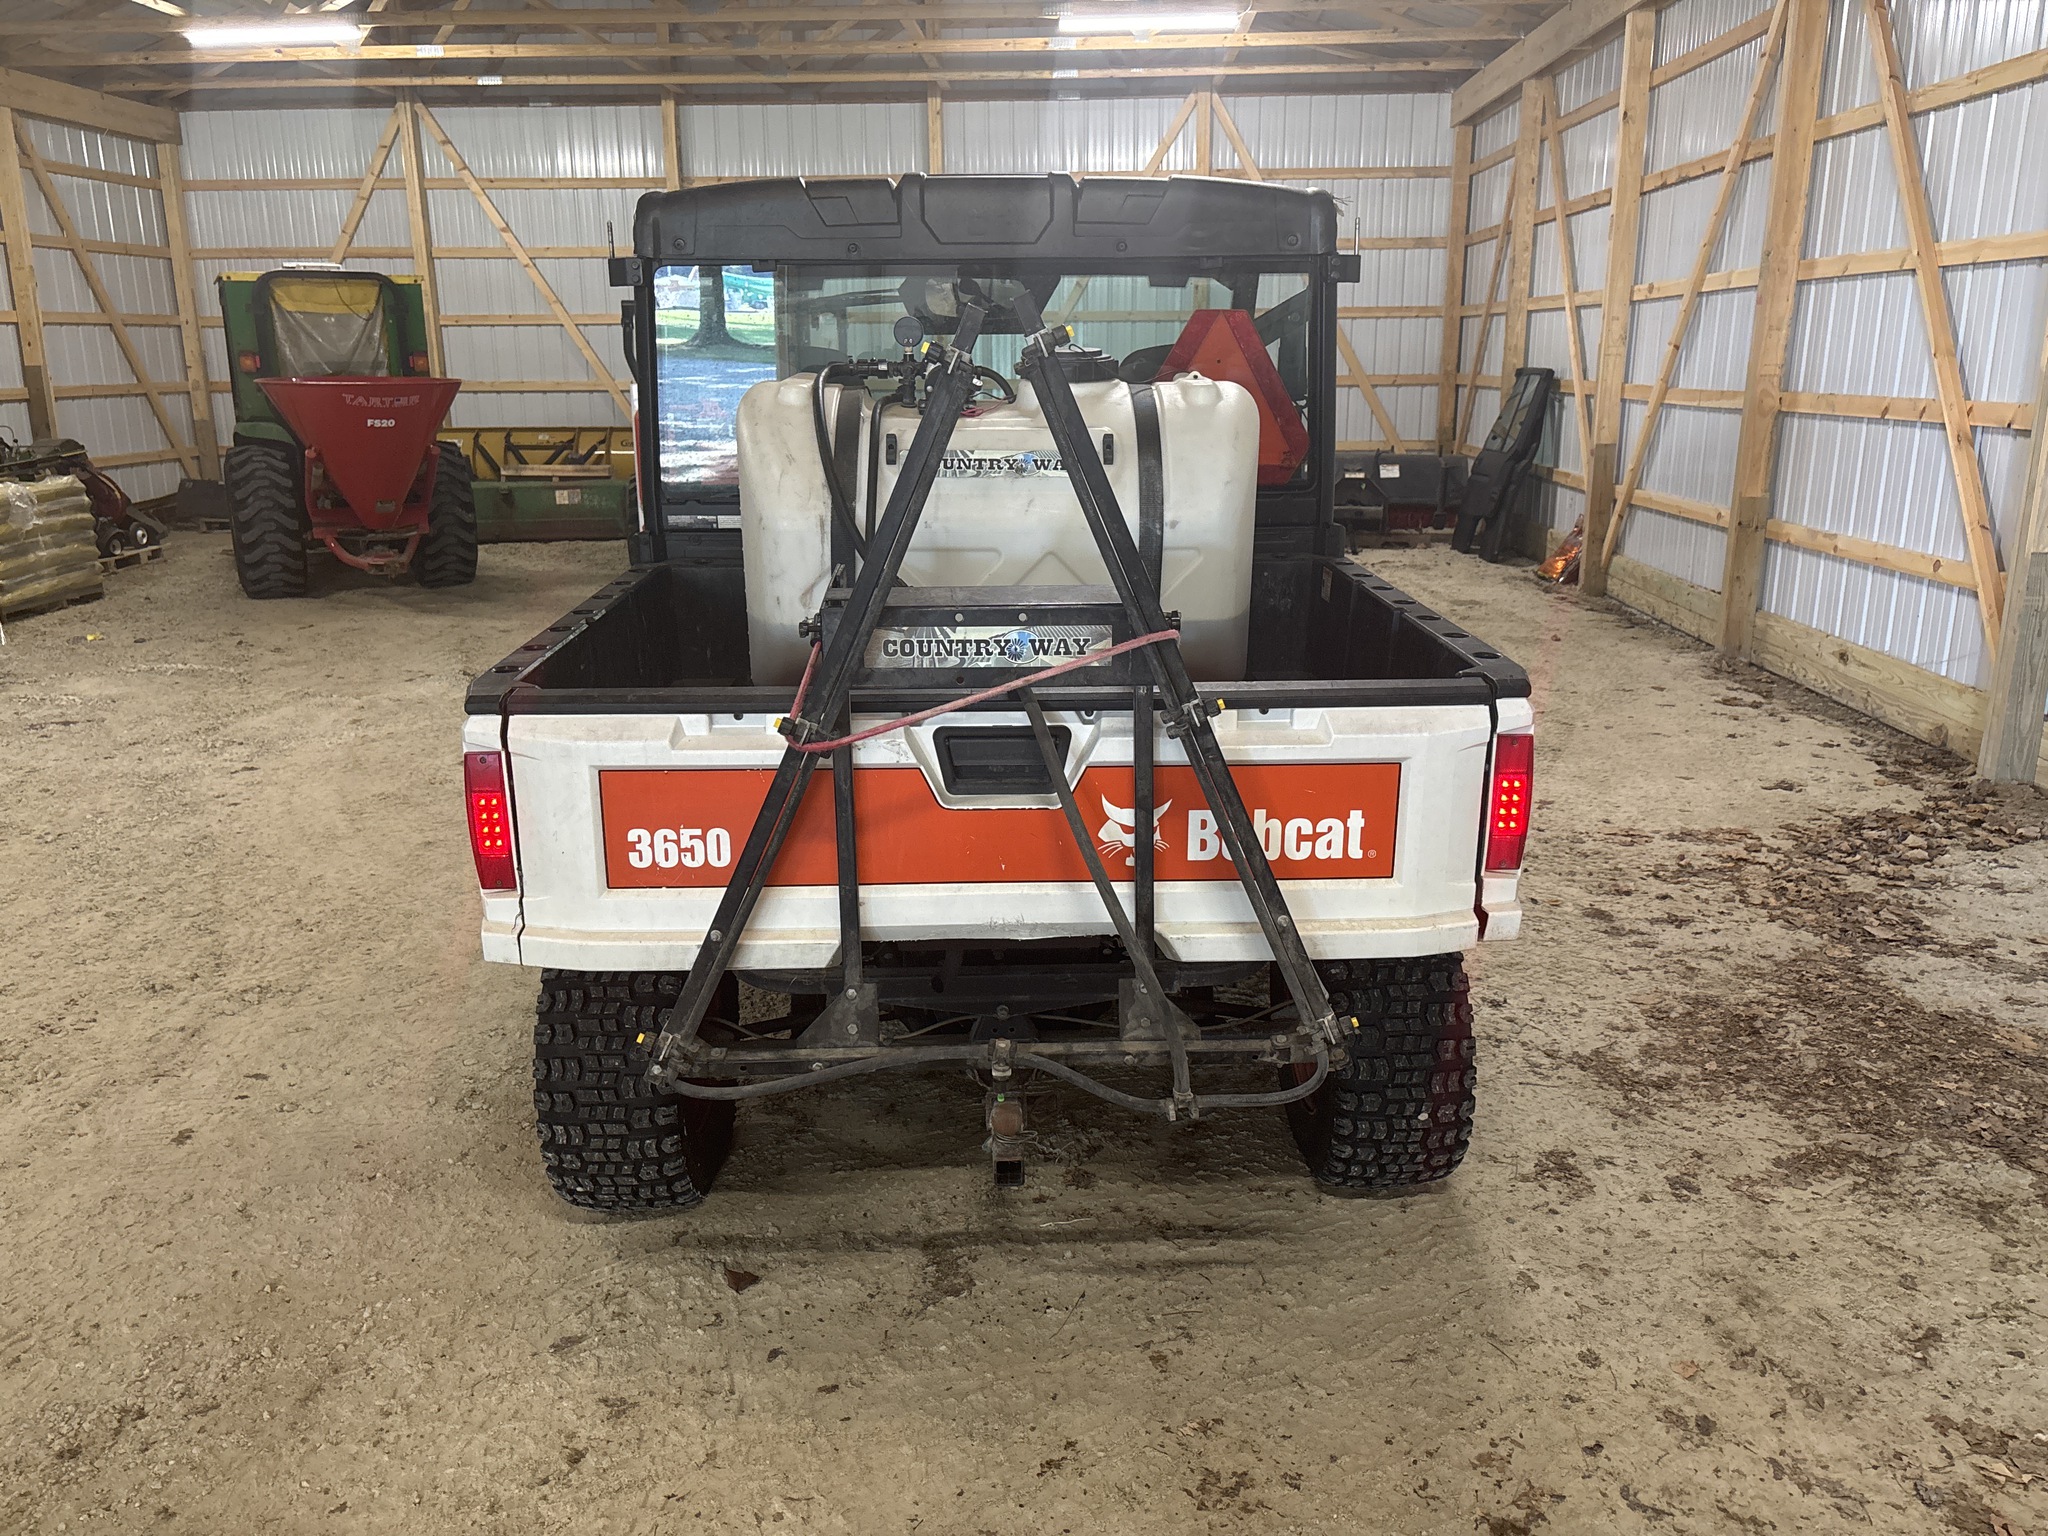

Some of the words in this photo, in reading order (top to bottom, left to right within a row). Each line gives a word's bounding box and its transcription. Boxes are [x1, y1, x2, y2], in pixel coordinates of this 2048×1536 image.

[366, 418, 396, 428] FS20
[938, 457, 1018, 471] UNTRY
[1032, 457, 1068, 471] WA
[882, 638, 1011, 658] COUNTRY
[1028, 637, 1091, 656] WAY
[627, 827, 732, 869] 3650
